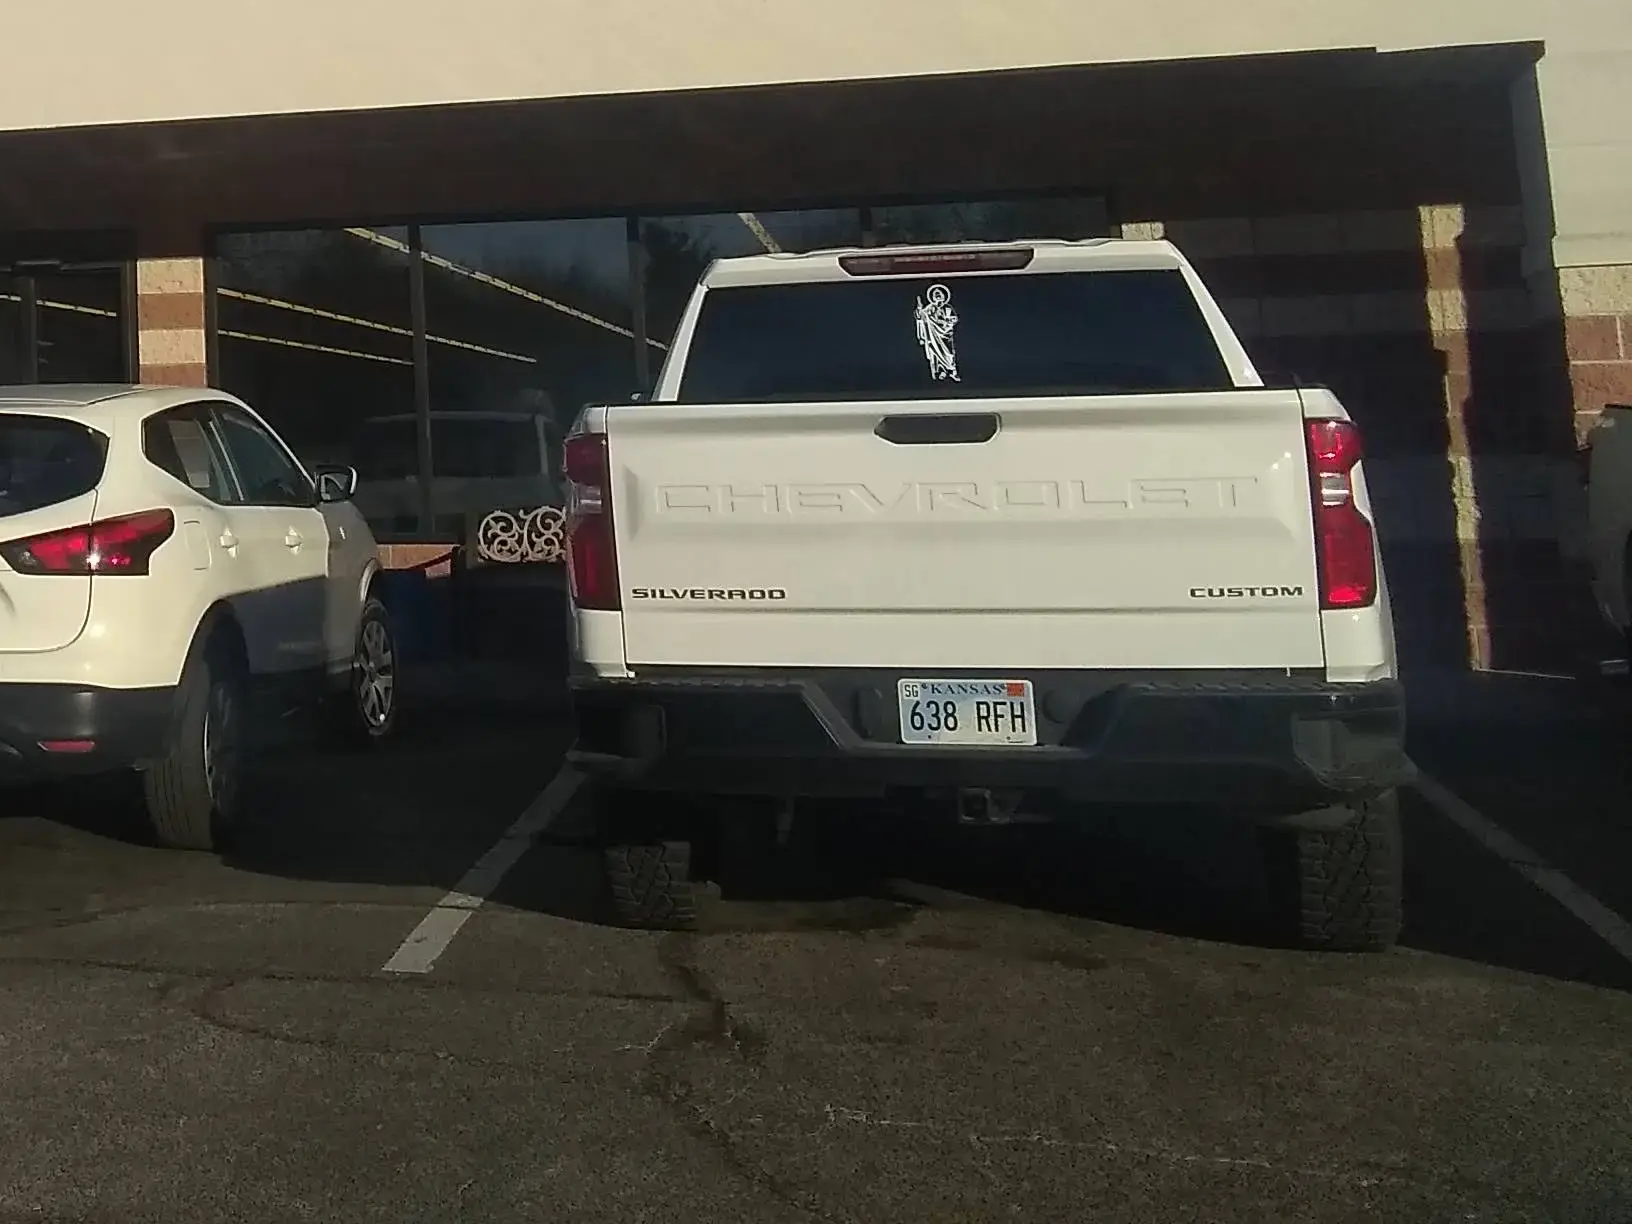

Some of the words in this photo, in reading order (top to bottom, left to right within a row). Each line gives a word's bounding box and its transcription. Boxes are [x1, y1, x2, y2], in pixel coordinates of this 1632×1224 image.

[655, 476, 1258, 514] CHEVROLET
[631, 588, 786, 600] SILVERADO
[1189, 586, 1304, 598] CUSTOM
[904, 684, 919, 698] SG
[930, 684, 1003, 695] KANSAS
[910, 700, 958, 732] 638
[975, 701, 1027, 733] RFH
